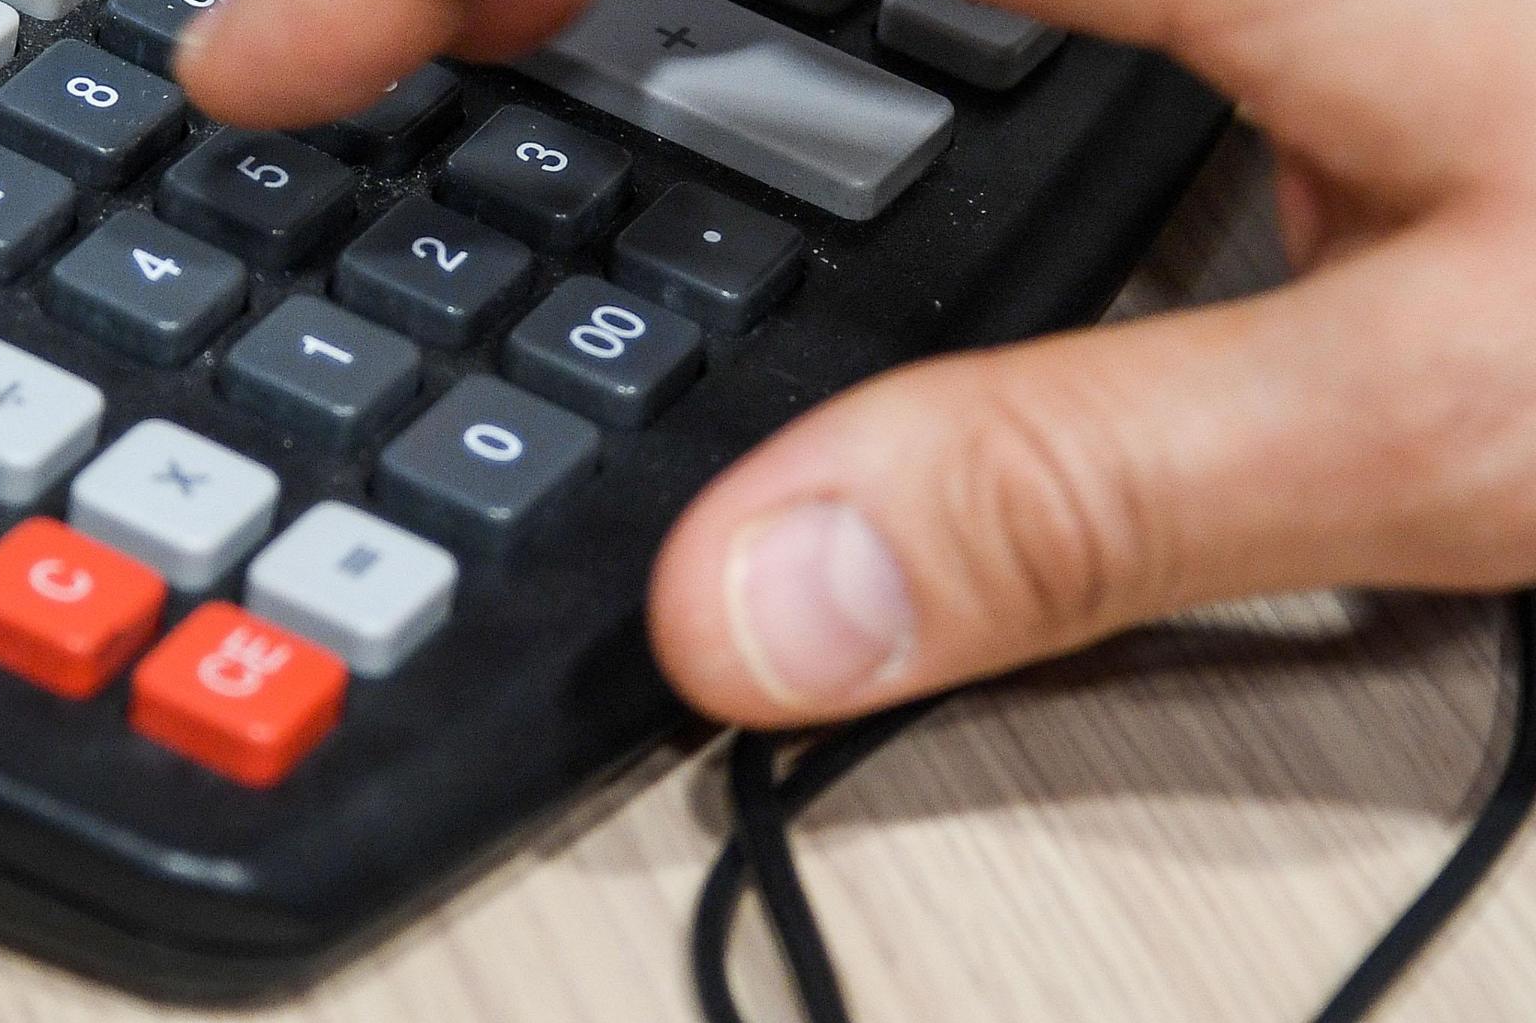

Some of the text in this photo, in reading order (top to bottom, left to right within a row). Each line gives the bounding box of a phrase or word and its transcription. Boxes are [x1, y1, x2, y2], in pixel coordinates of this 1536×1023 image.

[66, 76, 119, 108] 8
[236, 155, 289, 189] 5
[516, 142, 569, 172] 3
[132, 247, 182, 282] 4
[411, 236, 469, 272] 2
[301, 334, 354, 364] 1
[569, 305, 646, 359] 00
[463, 423, 524, 463] 0
[28, 558, 94, 603] C
[197, 628, 293, 698] CE
